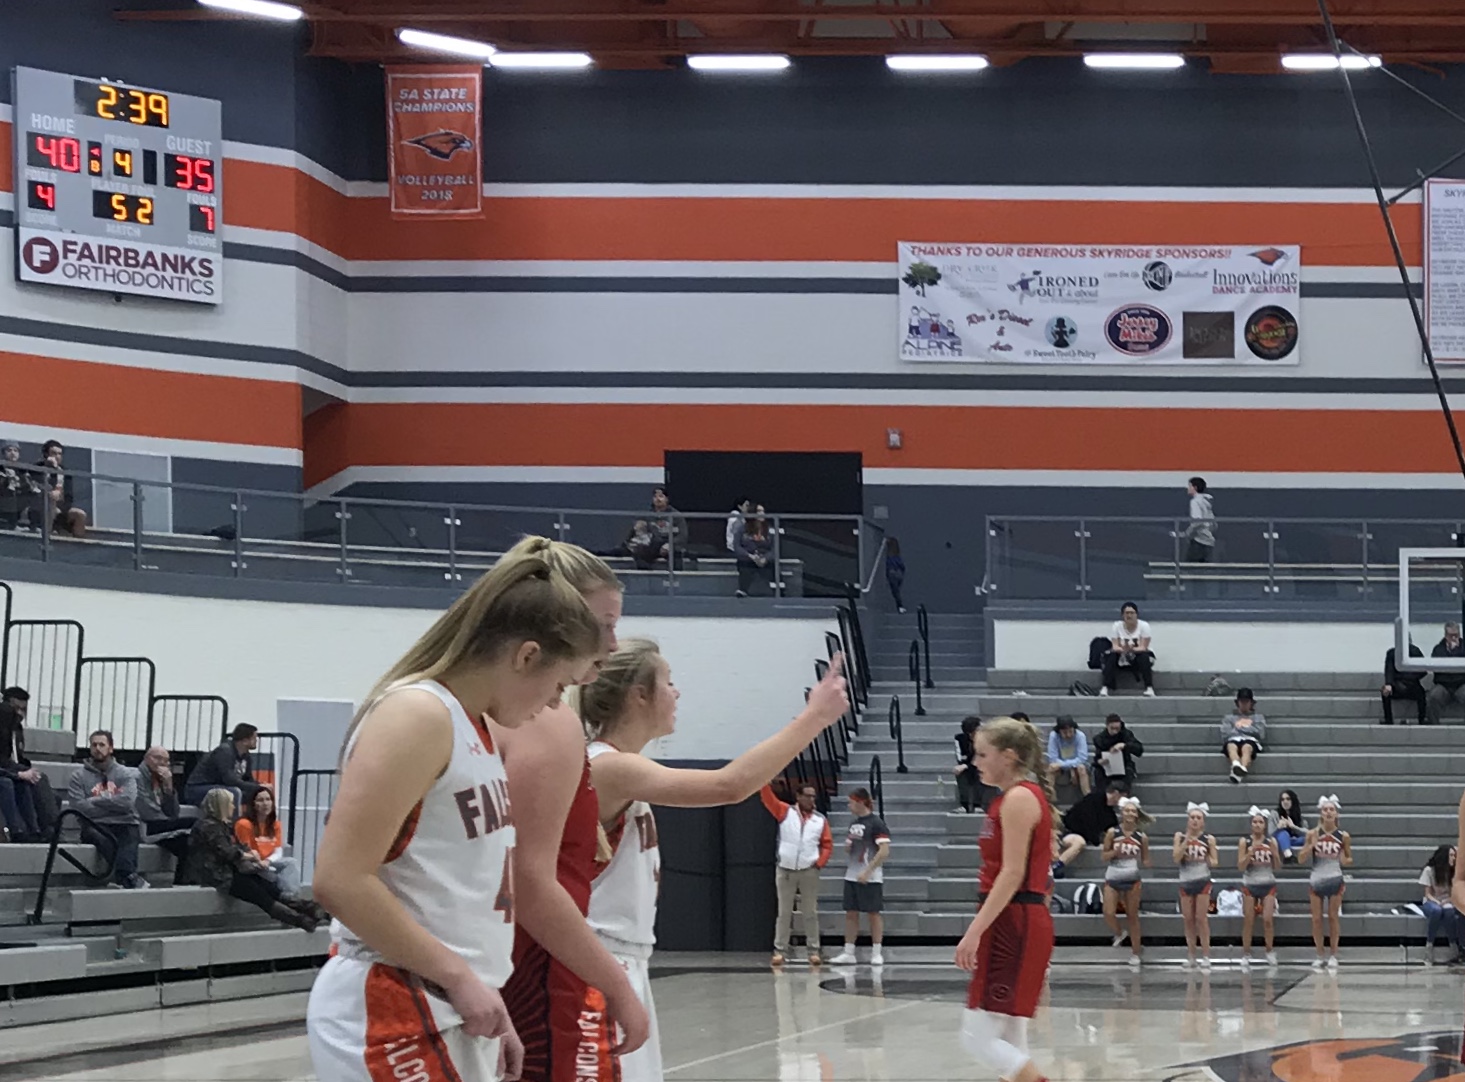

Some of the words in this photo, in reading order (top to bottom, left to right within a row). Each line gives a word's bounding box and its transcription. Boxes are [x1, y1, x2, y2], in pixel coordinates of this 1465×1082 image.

[422, 88, 467, 100] STATE
[97, 85, 169, 126] 2:39
[394, 102, 475, 113] CHAMPIONS
[31, 113, 76, 134] HOME
[36, 136, 81, 172] 40
[166, 135, 212, 155] GUEST
[114, 151, 131, 175] 4
[176, 156, 213, 191] 35
[397, 174, 475, 186] VOLLEYBALL
[36, 184, 55, 208] 4
[200, 207, 214, 230] 7
[62, 240, 214, 278] FAIRBANKS
[910, 245, 962, 256] THANKS
[965, 246, 983, 257] TO
[985, 246, 1014, 257] OUR
[1017, 247, 1086, 258] GENEROUS
[1090, 248, 1152, 259] SKYRIDGE
[1155, 249, 1232, 259] SPONSORS!!
[62, 262, 214, 295] ORTHODONTICS
[1038, 276, 1100, 287] IRONED
[1213, 268, 1298, 286] Innovations
[1036, 288, 1062, 297] OUT
[1213, 286, 1246, 294] DANCE
[1250, 286, 1298, 294] ACADEMY
[1117, 312, 1159, 332] Jersey
[1315, 841, 1341, 856] SHS
